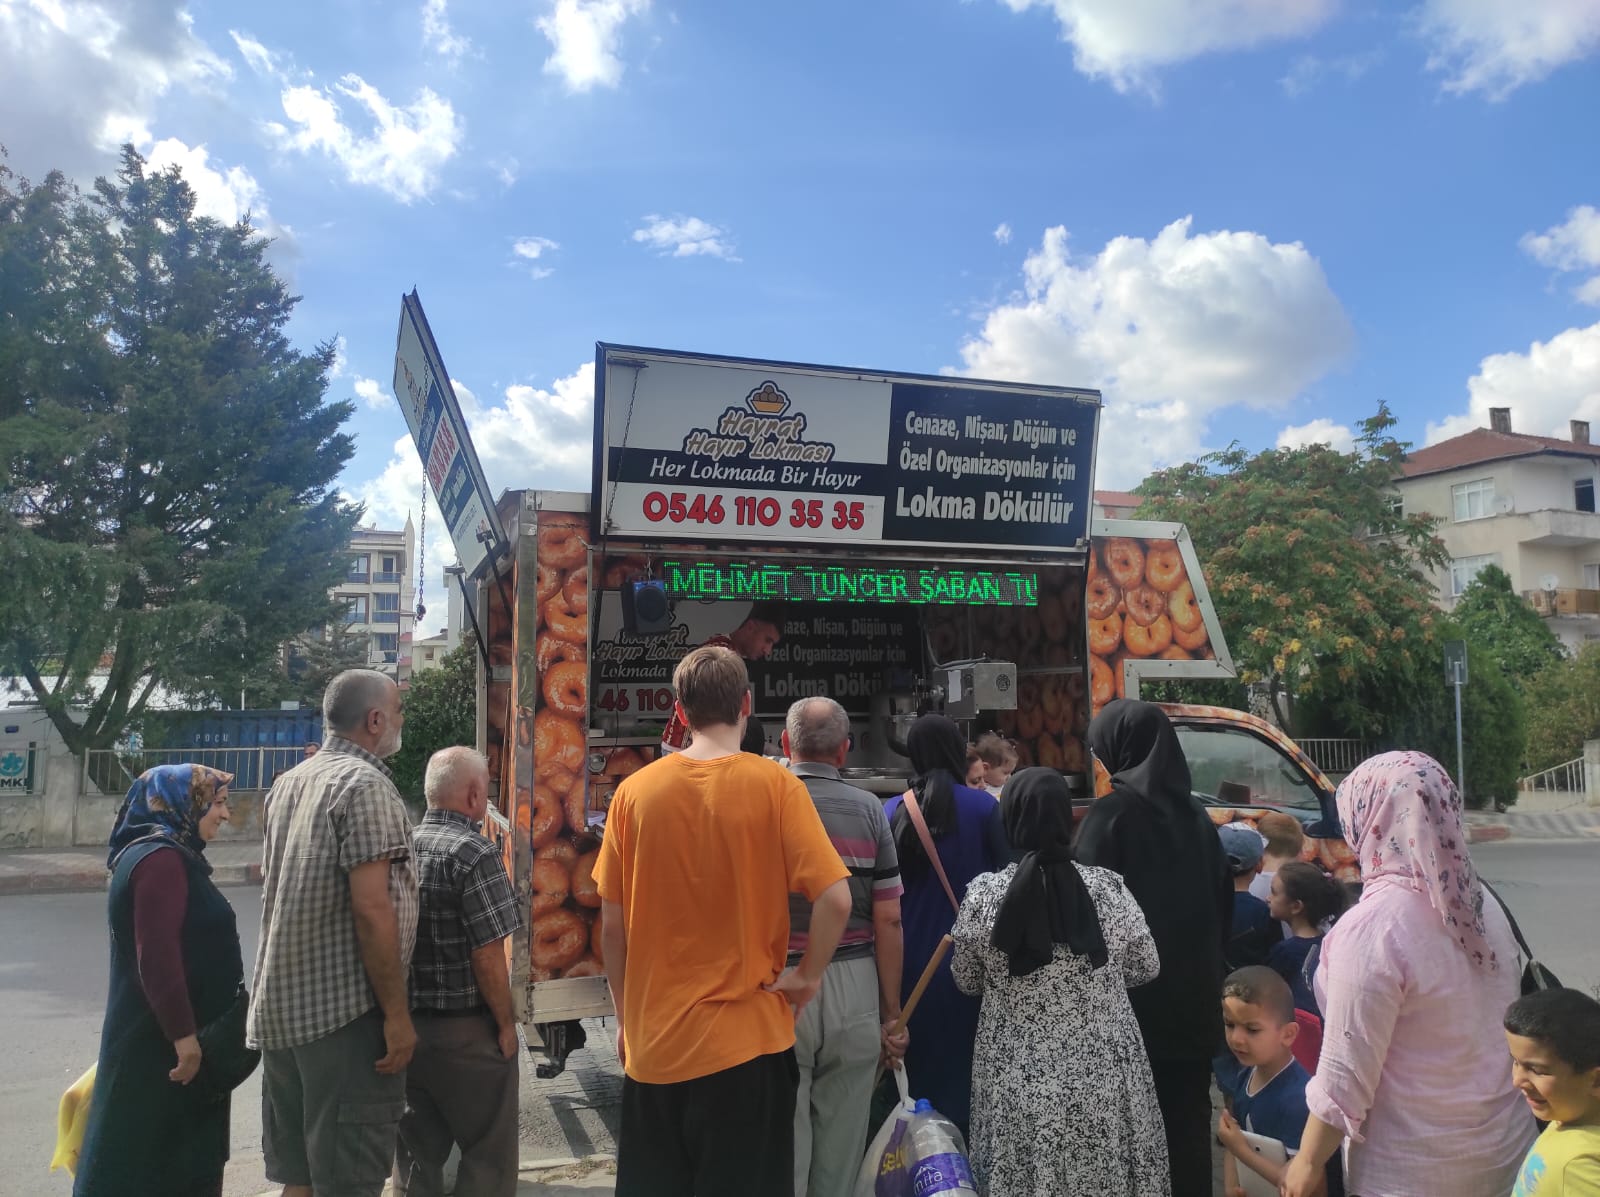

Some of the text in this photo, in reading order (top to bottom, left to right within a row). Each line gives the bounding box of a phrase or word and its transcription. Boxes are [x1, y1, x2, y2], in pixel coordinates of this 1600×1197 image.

[719, 409, 804, 441] Hayrat
[905, 410, 1077, 449] Cenaze, Nişan, Düğün ve
[685, 432, 834, 464] Hayır Lokması
[900, 441, 1076, 485] Özel Organizasyonlar için
[649, 456, 862, 491] Her Lokmada Bir Hayır
[642, 491, 865, 531] 0546 110 35 35
[896, 485, 1074, 524] Lokma Dökülür
[673, 568, 793, 594] MEHMET
[804, 572, 908, 597] TUNCER
[784, 617, 903, 640] aze, Nişan, Düğün ve
[646, 642, 698, 661] Lokm
[793, 643, 884, 666] Organizasyonlar
[600, 664, 667, 678] Lokmada
[764, 672, 882, 697] Lokma Dökü
[597, 688, 674, 712] 46 110
